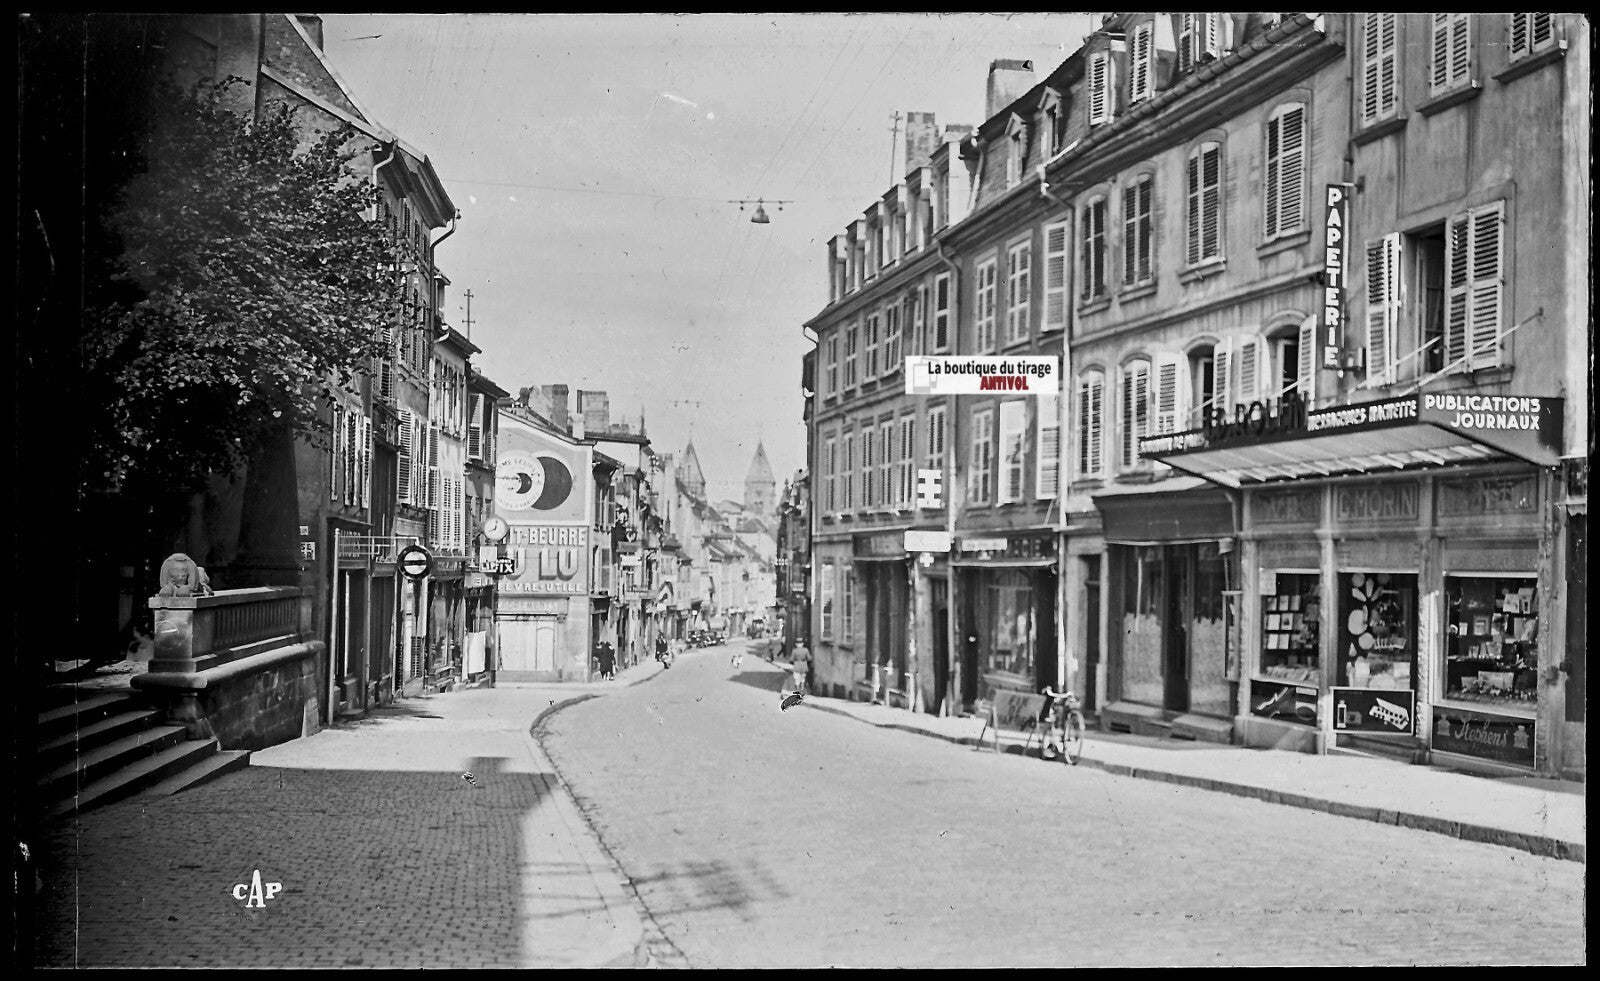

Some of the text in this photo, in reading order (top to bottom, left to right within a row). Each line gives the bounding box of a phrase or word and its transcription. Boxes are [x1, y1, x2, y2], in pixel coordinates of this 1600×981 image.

[1325, 187, 1342, 366] PAPETERIE
[1424, 394, 1541, 413] PUBLICATIONS
[1450, 412, 1540, 431] JOURNAUX
[503, 527, 586, 546] IT-BEURRE
[539, 546, 578, 580] LU
